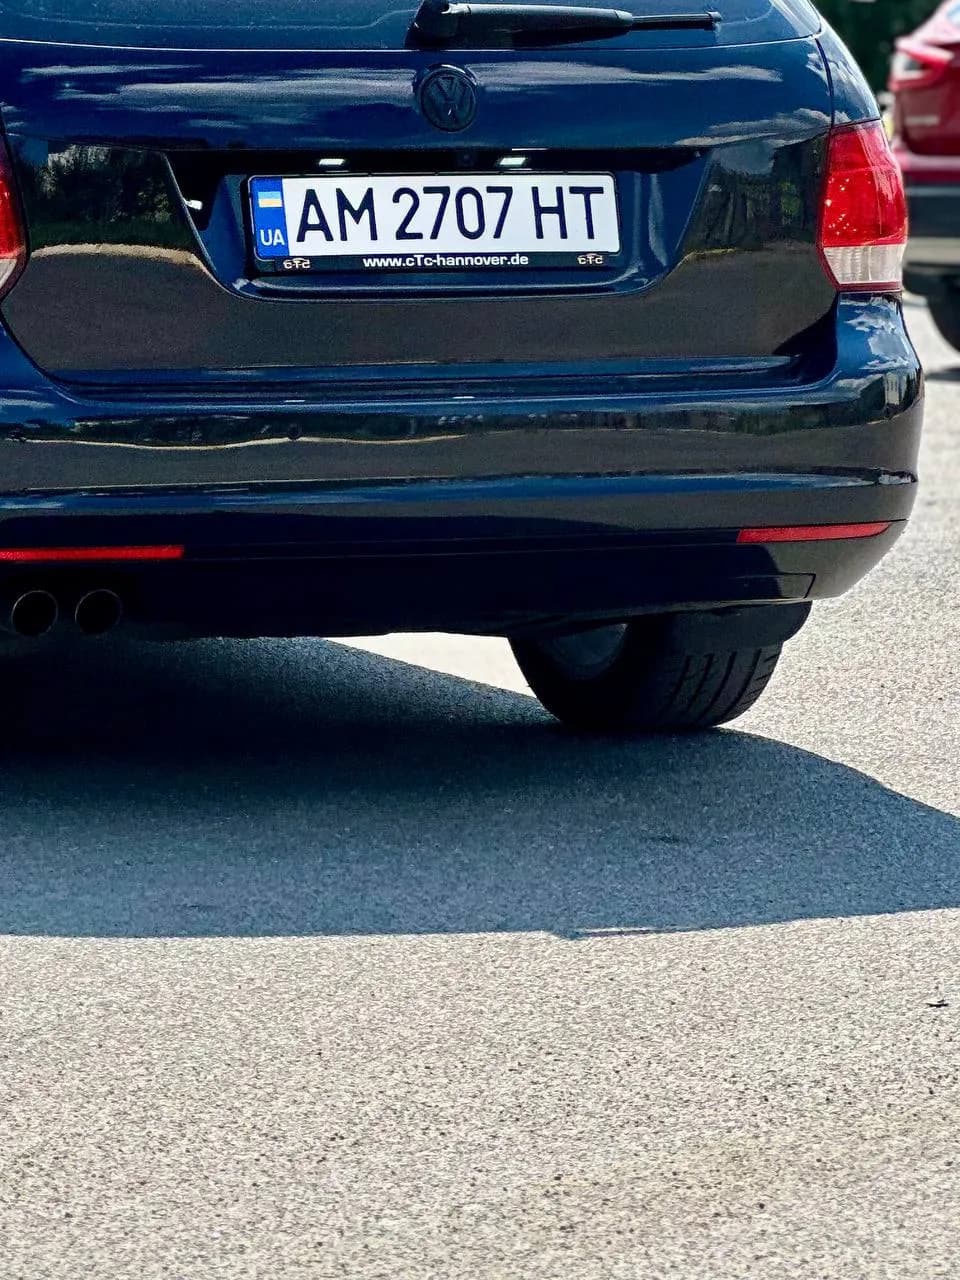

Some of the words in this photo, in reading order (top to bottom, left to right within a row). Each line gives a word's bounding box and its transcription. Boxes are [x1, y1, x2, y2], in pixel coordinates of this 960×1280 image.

[296, 187, 378, 242] AM
[392, 186, 513, 240] 2707
[531, 186, 604, 240] HT
[260, 230, 285, 246] UA
[362, 253, 529, 268] www.cTc-hannover.de
